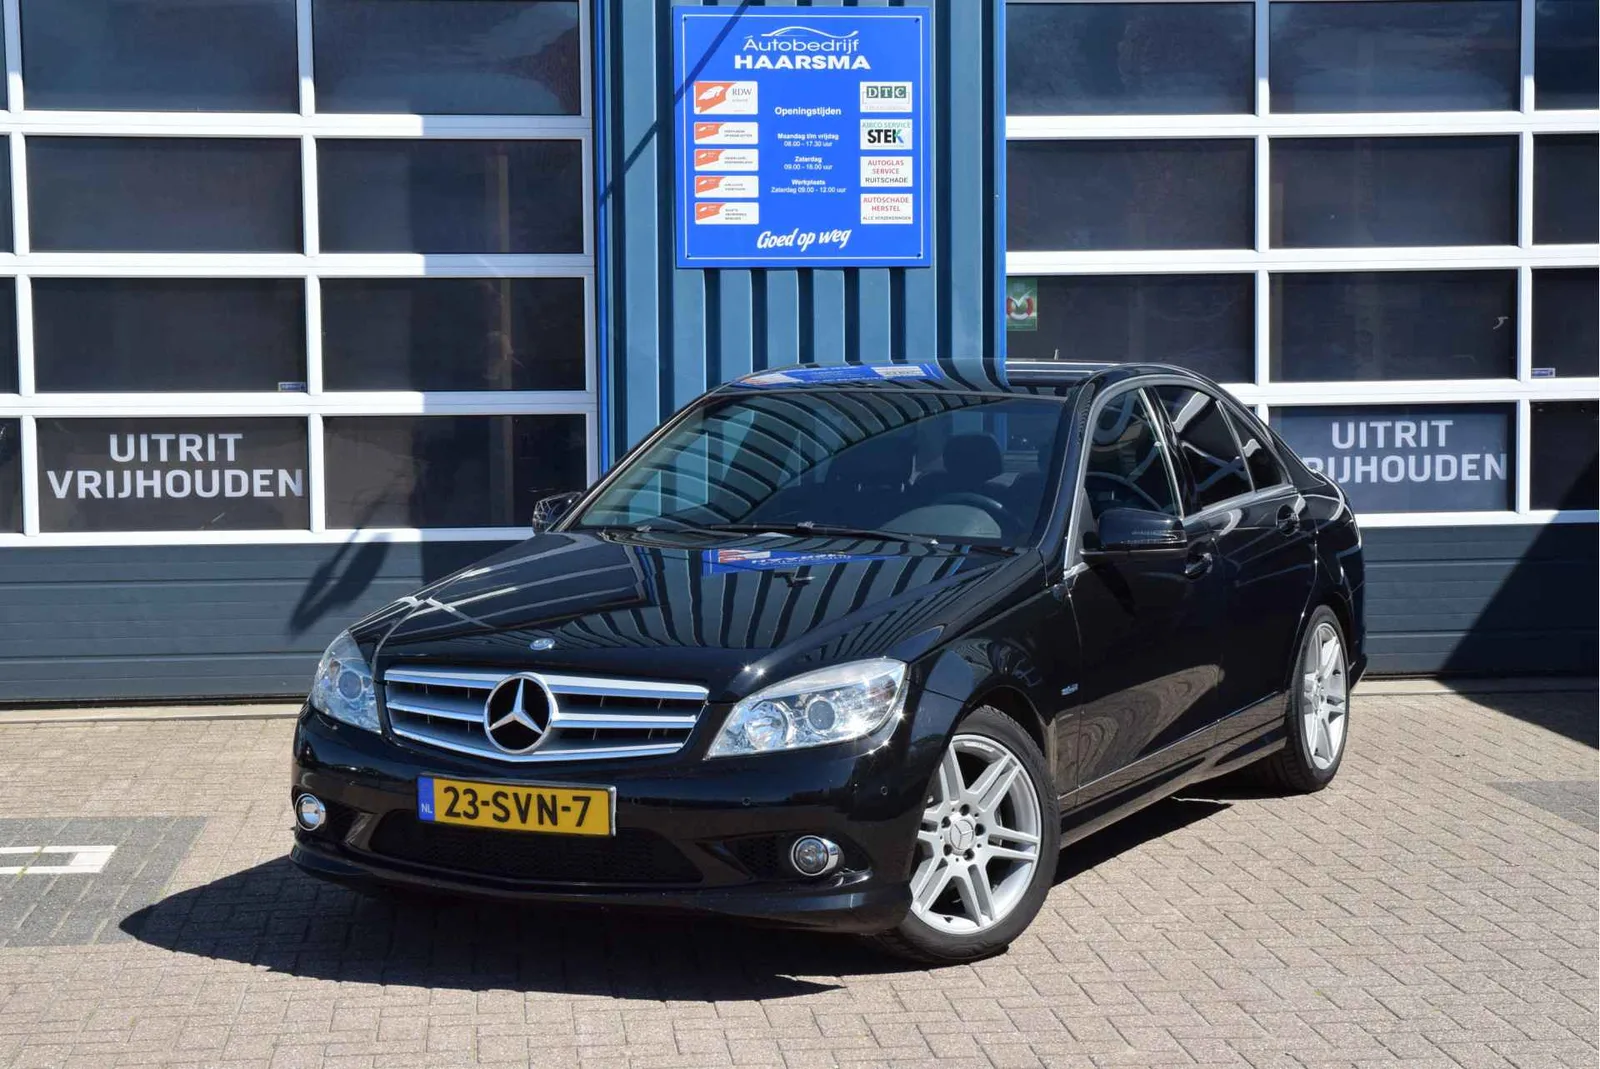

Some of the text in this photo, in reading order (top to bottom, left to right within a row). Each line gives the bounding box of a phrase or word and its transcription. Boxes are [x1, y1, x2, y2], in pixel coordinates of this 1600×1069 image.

[743, 37, 859, 54] Autobedrijf
[734, 54, 871, 70] HAARSMA
[732, 87, 752, 96] RDW
[866, 86, 907, 98] DTC
[774, 106, 842, 117] Openingstijden
[777, 133, 806, 141] Maandag
[818, 133, 839, 141] vrijdag
[867, 129, 905, 144] STEK
[770, 186, 797, 194] Zaterdag
[862, 196, 911, 204] AUTOSCHADE
[756, 227, 853, 253] Goed op weg
[1331, 420, 1454, 449] UITRIT
[109, 433, 244, 463] UITRIT
[46, 469, 304, 499] VRIJHOUDEN
[420, 802, 434, 814] NL
[443, 786, 592, 828] 23-SVN-7
